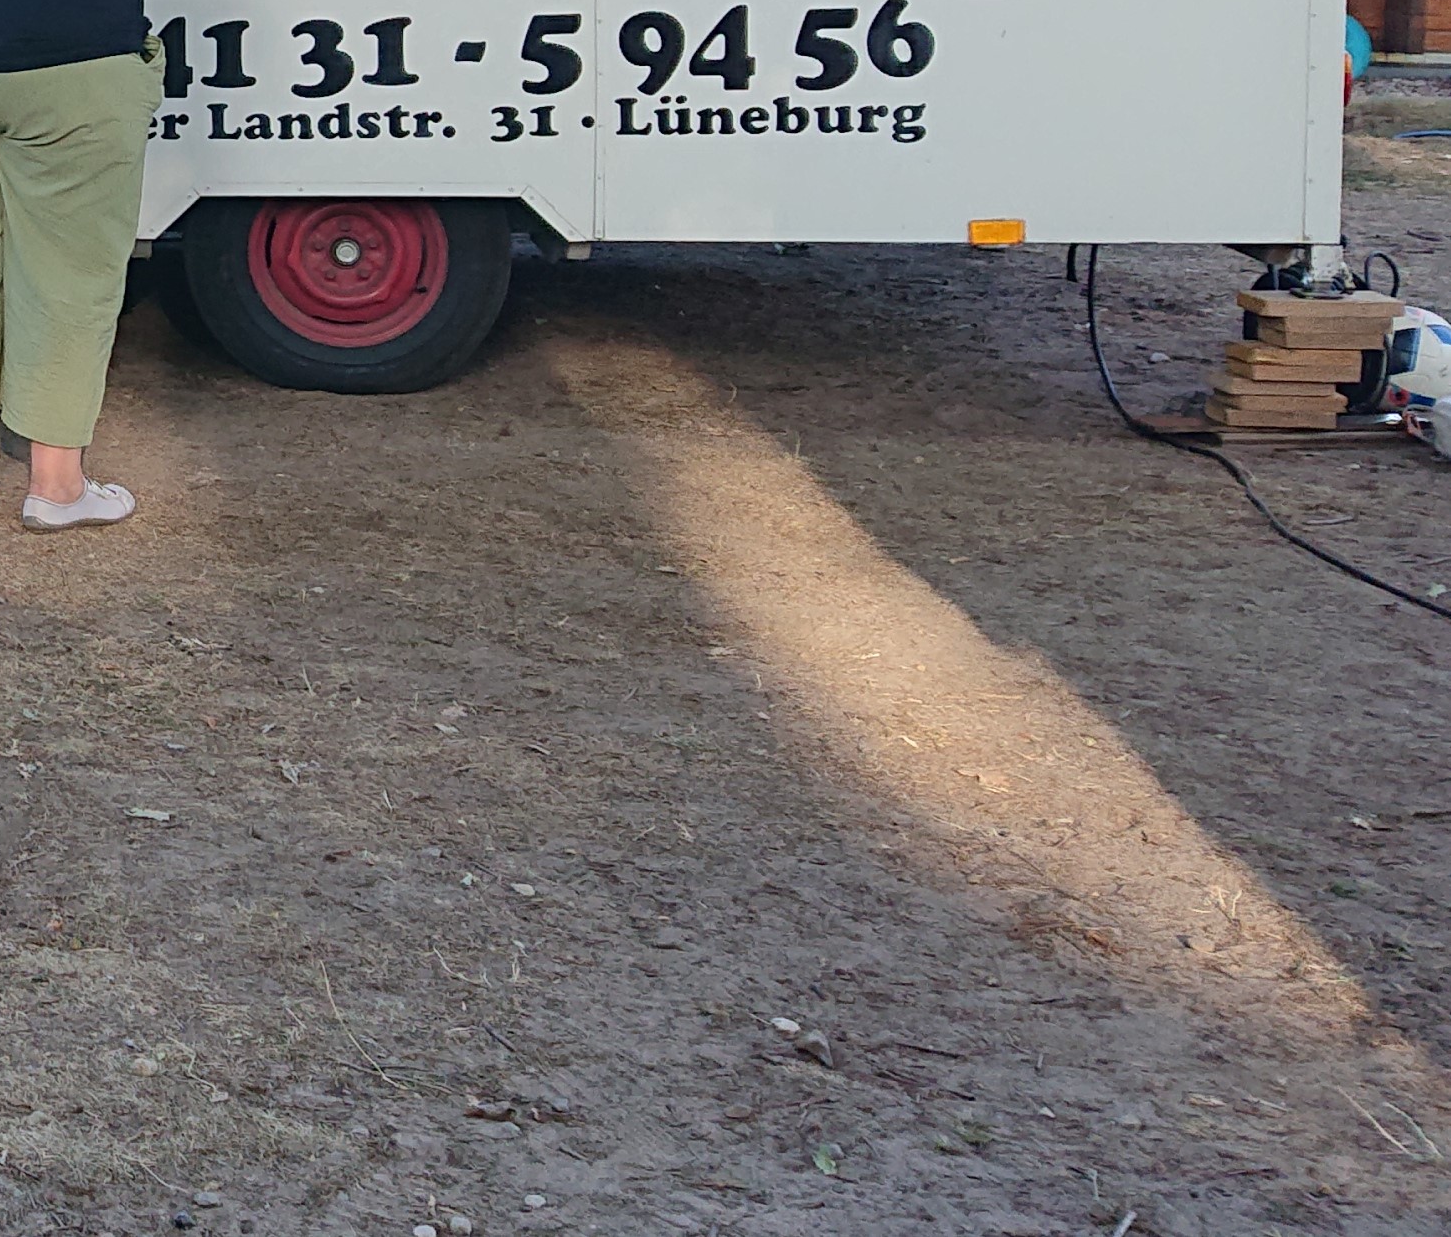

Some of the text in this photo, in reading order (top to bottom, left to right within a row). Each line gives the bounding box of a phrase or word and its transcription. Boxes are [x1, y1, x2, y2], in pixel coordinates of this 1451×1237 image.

[290, 16, 420, 99] 31
[520, 13, 583, 95] 5
[618, 4, 757, 96] 94
[207, 103, 457, 140] Landstr.
[490, 105, 560, 143] 31
[614, 95, 927, 144] Lüneburg
